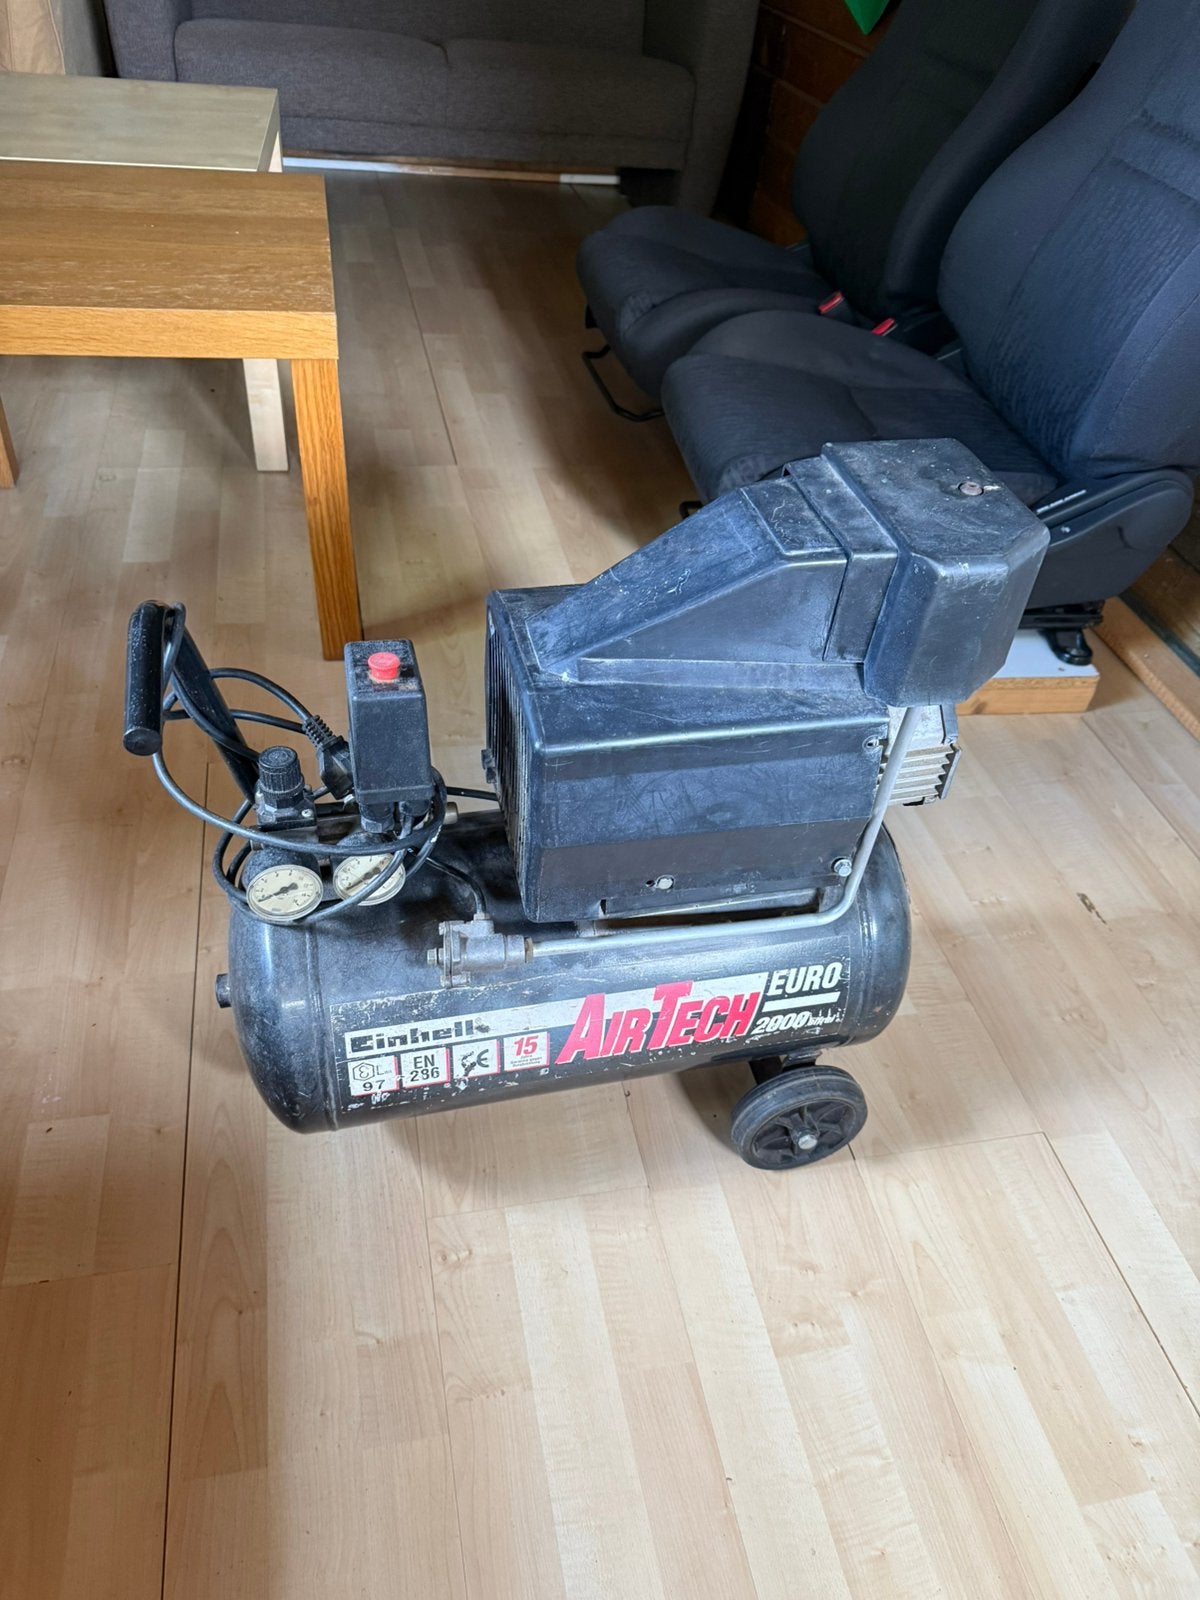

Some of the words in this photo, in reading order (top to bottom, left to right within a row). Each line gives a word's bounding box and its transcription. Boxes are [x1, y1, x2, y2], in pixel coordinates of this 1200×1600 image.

[766, 962, 843, 996] EURO
[349, 1020, 474, 1053] Einhell
[514, 1035, 539, 1056] 15
[413, 1054, 436, 1070] EN
[410, 1067, 440, 1082] 286
[362, 1080, 386, 1092] 97
